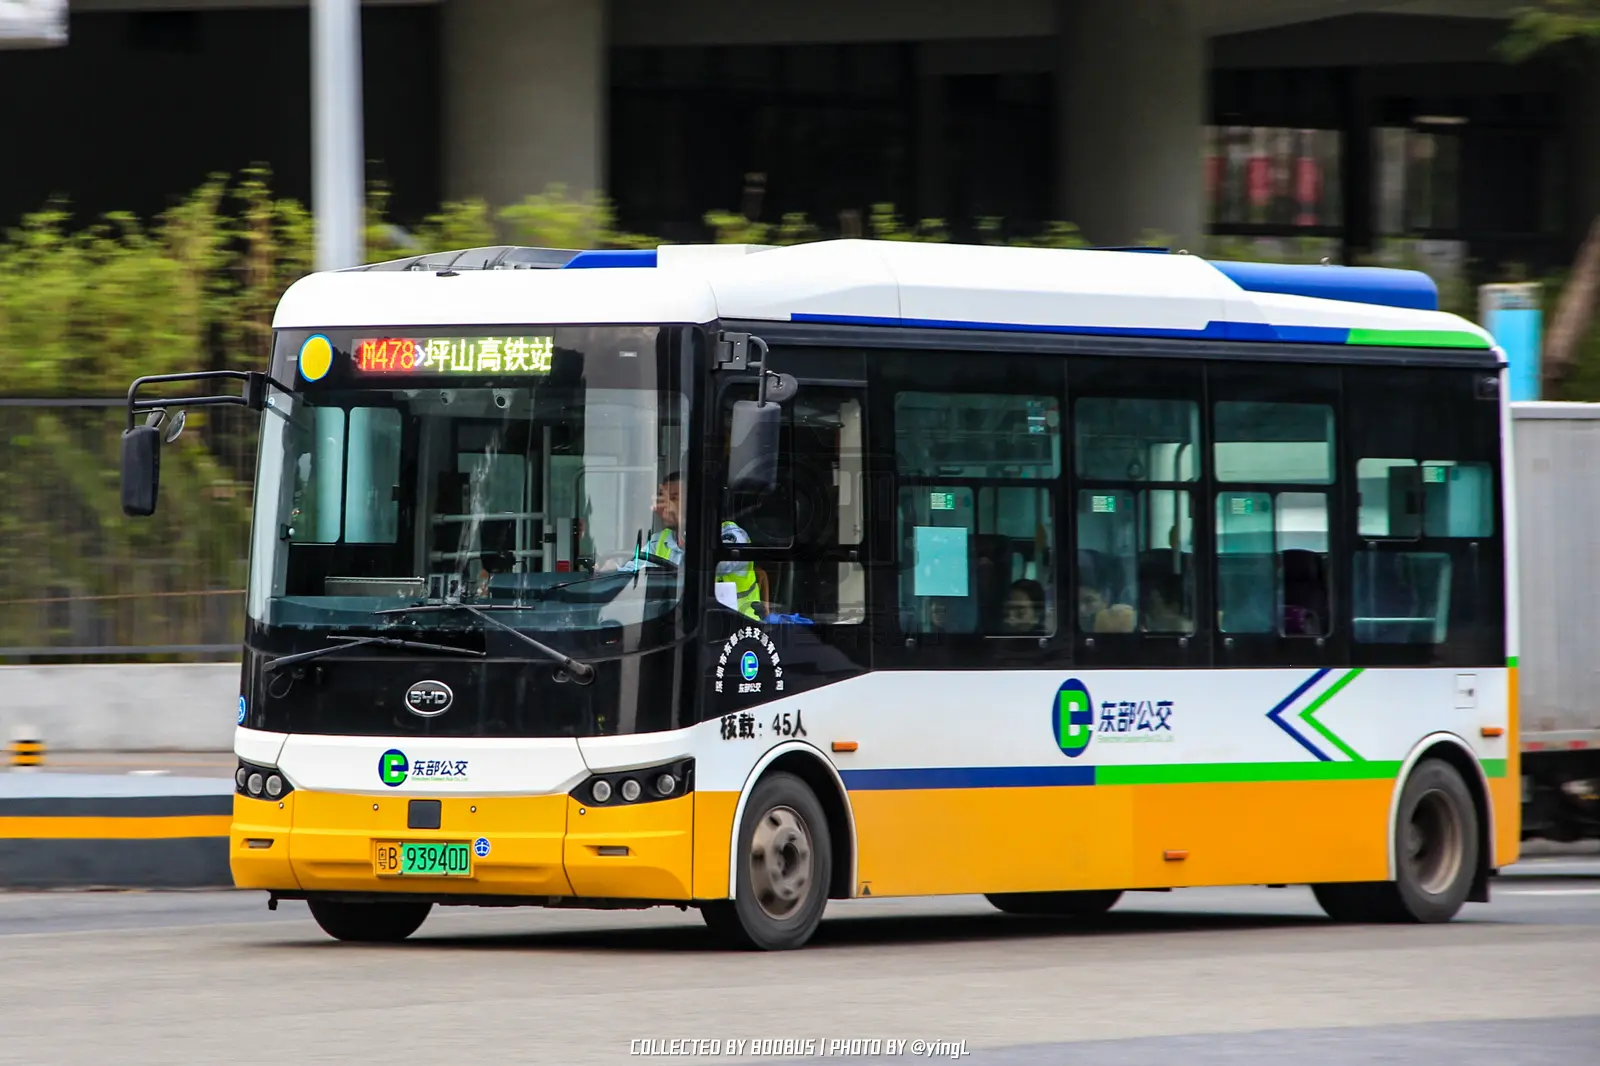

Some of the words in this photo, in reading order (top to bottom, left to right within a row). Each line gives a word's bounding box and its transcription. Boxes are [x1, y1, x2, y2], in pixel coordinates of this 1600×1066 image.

[361, 340, 415, 369] M478
[423, 336, 553, 372] 坪山高铁站
[410, 690, 447, 704] BYD
[1098, 700, 1174, 732] 东部公交
[412, 760, 469, 777] 东部公交
